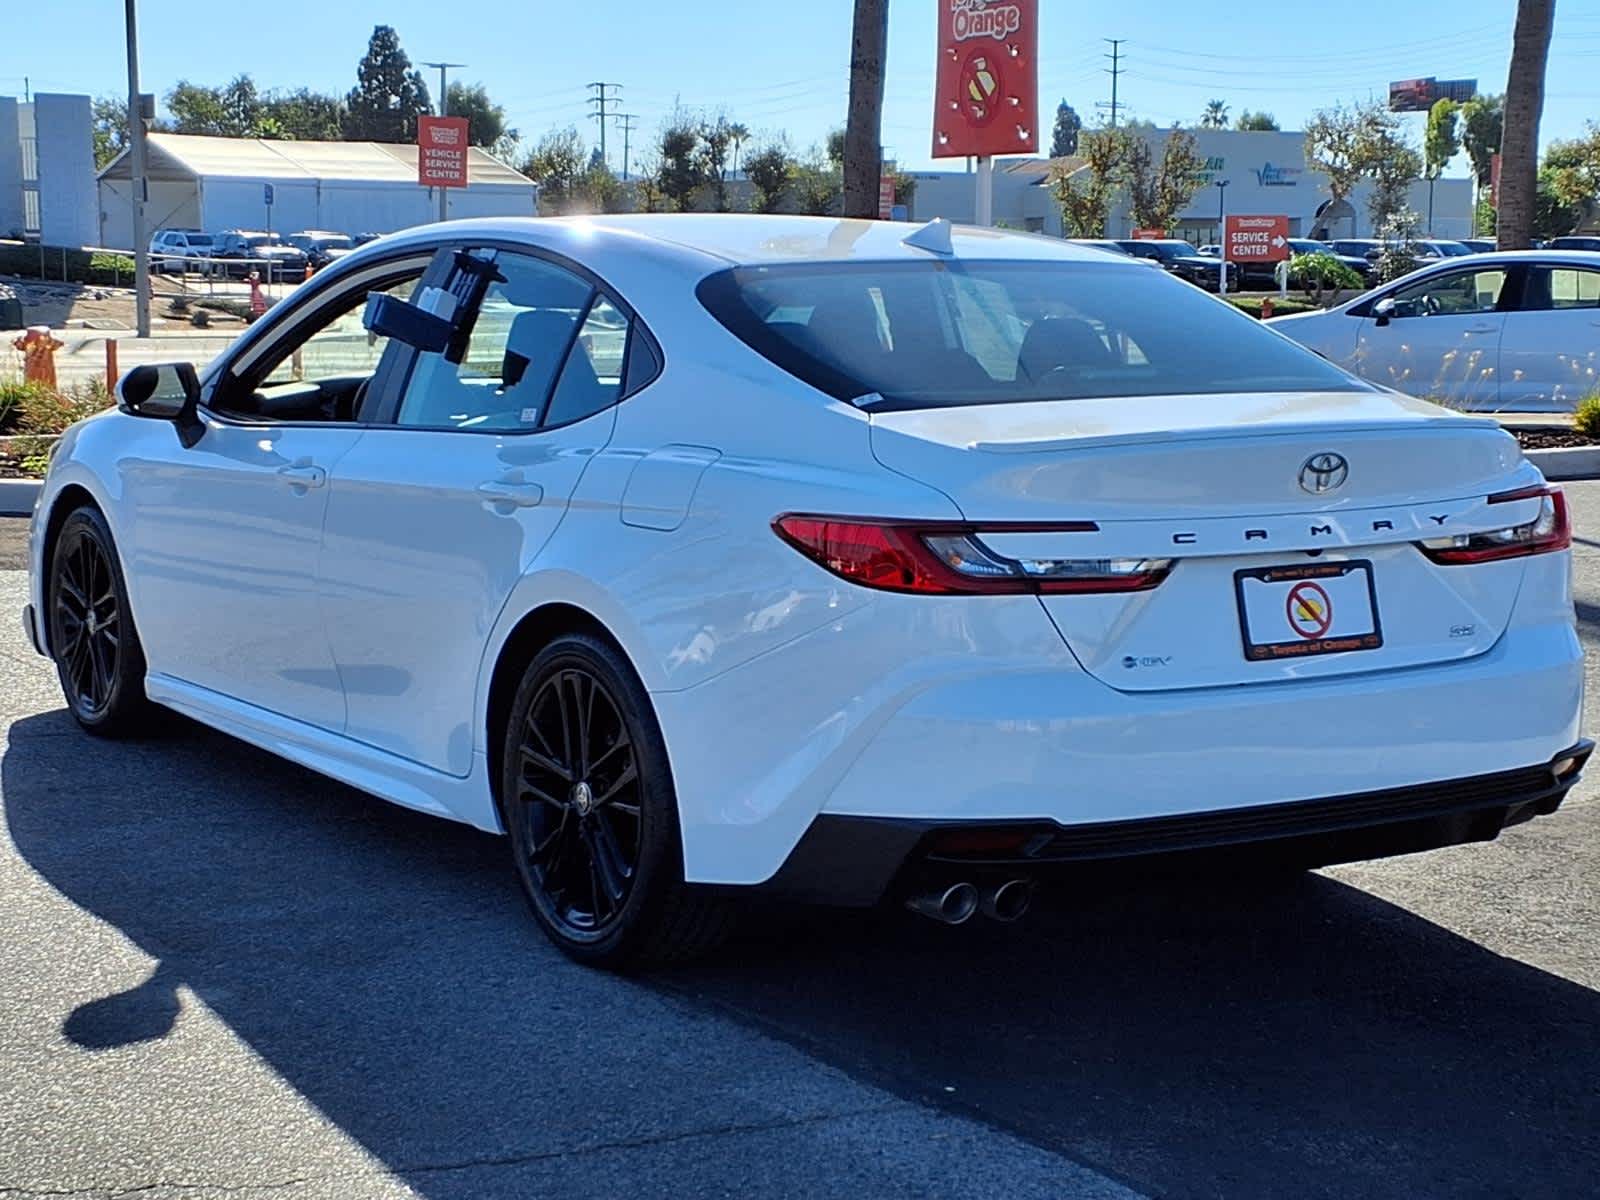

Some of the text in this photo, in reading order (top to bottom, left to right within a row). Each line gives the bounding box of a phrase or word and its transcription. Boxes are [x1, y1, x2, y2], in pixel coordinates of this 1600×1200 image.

[953, 5, 1019, 40] Orange
[424, 148, 461, 159] VEHICLE
[425, 158, 461, 168] SERVICE
[425, 169, 460, 179] CENTER
[1231, 231, 1269, 243] SERVICE
[1232, 244, 1269, 256] CENTER
[1172, 514, 1449, 544] CAMRY
